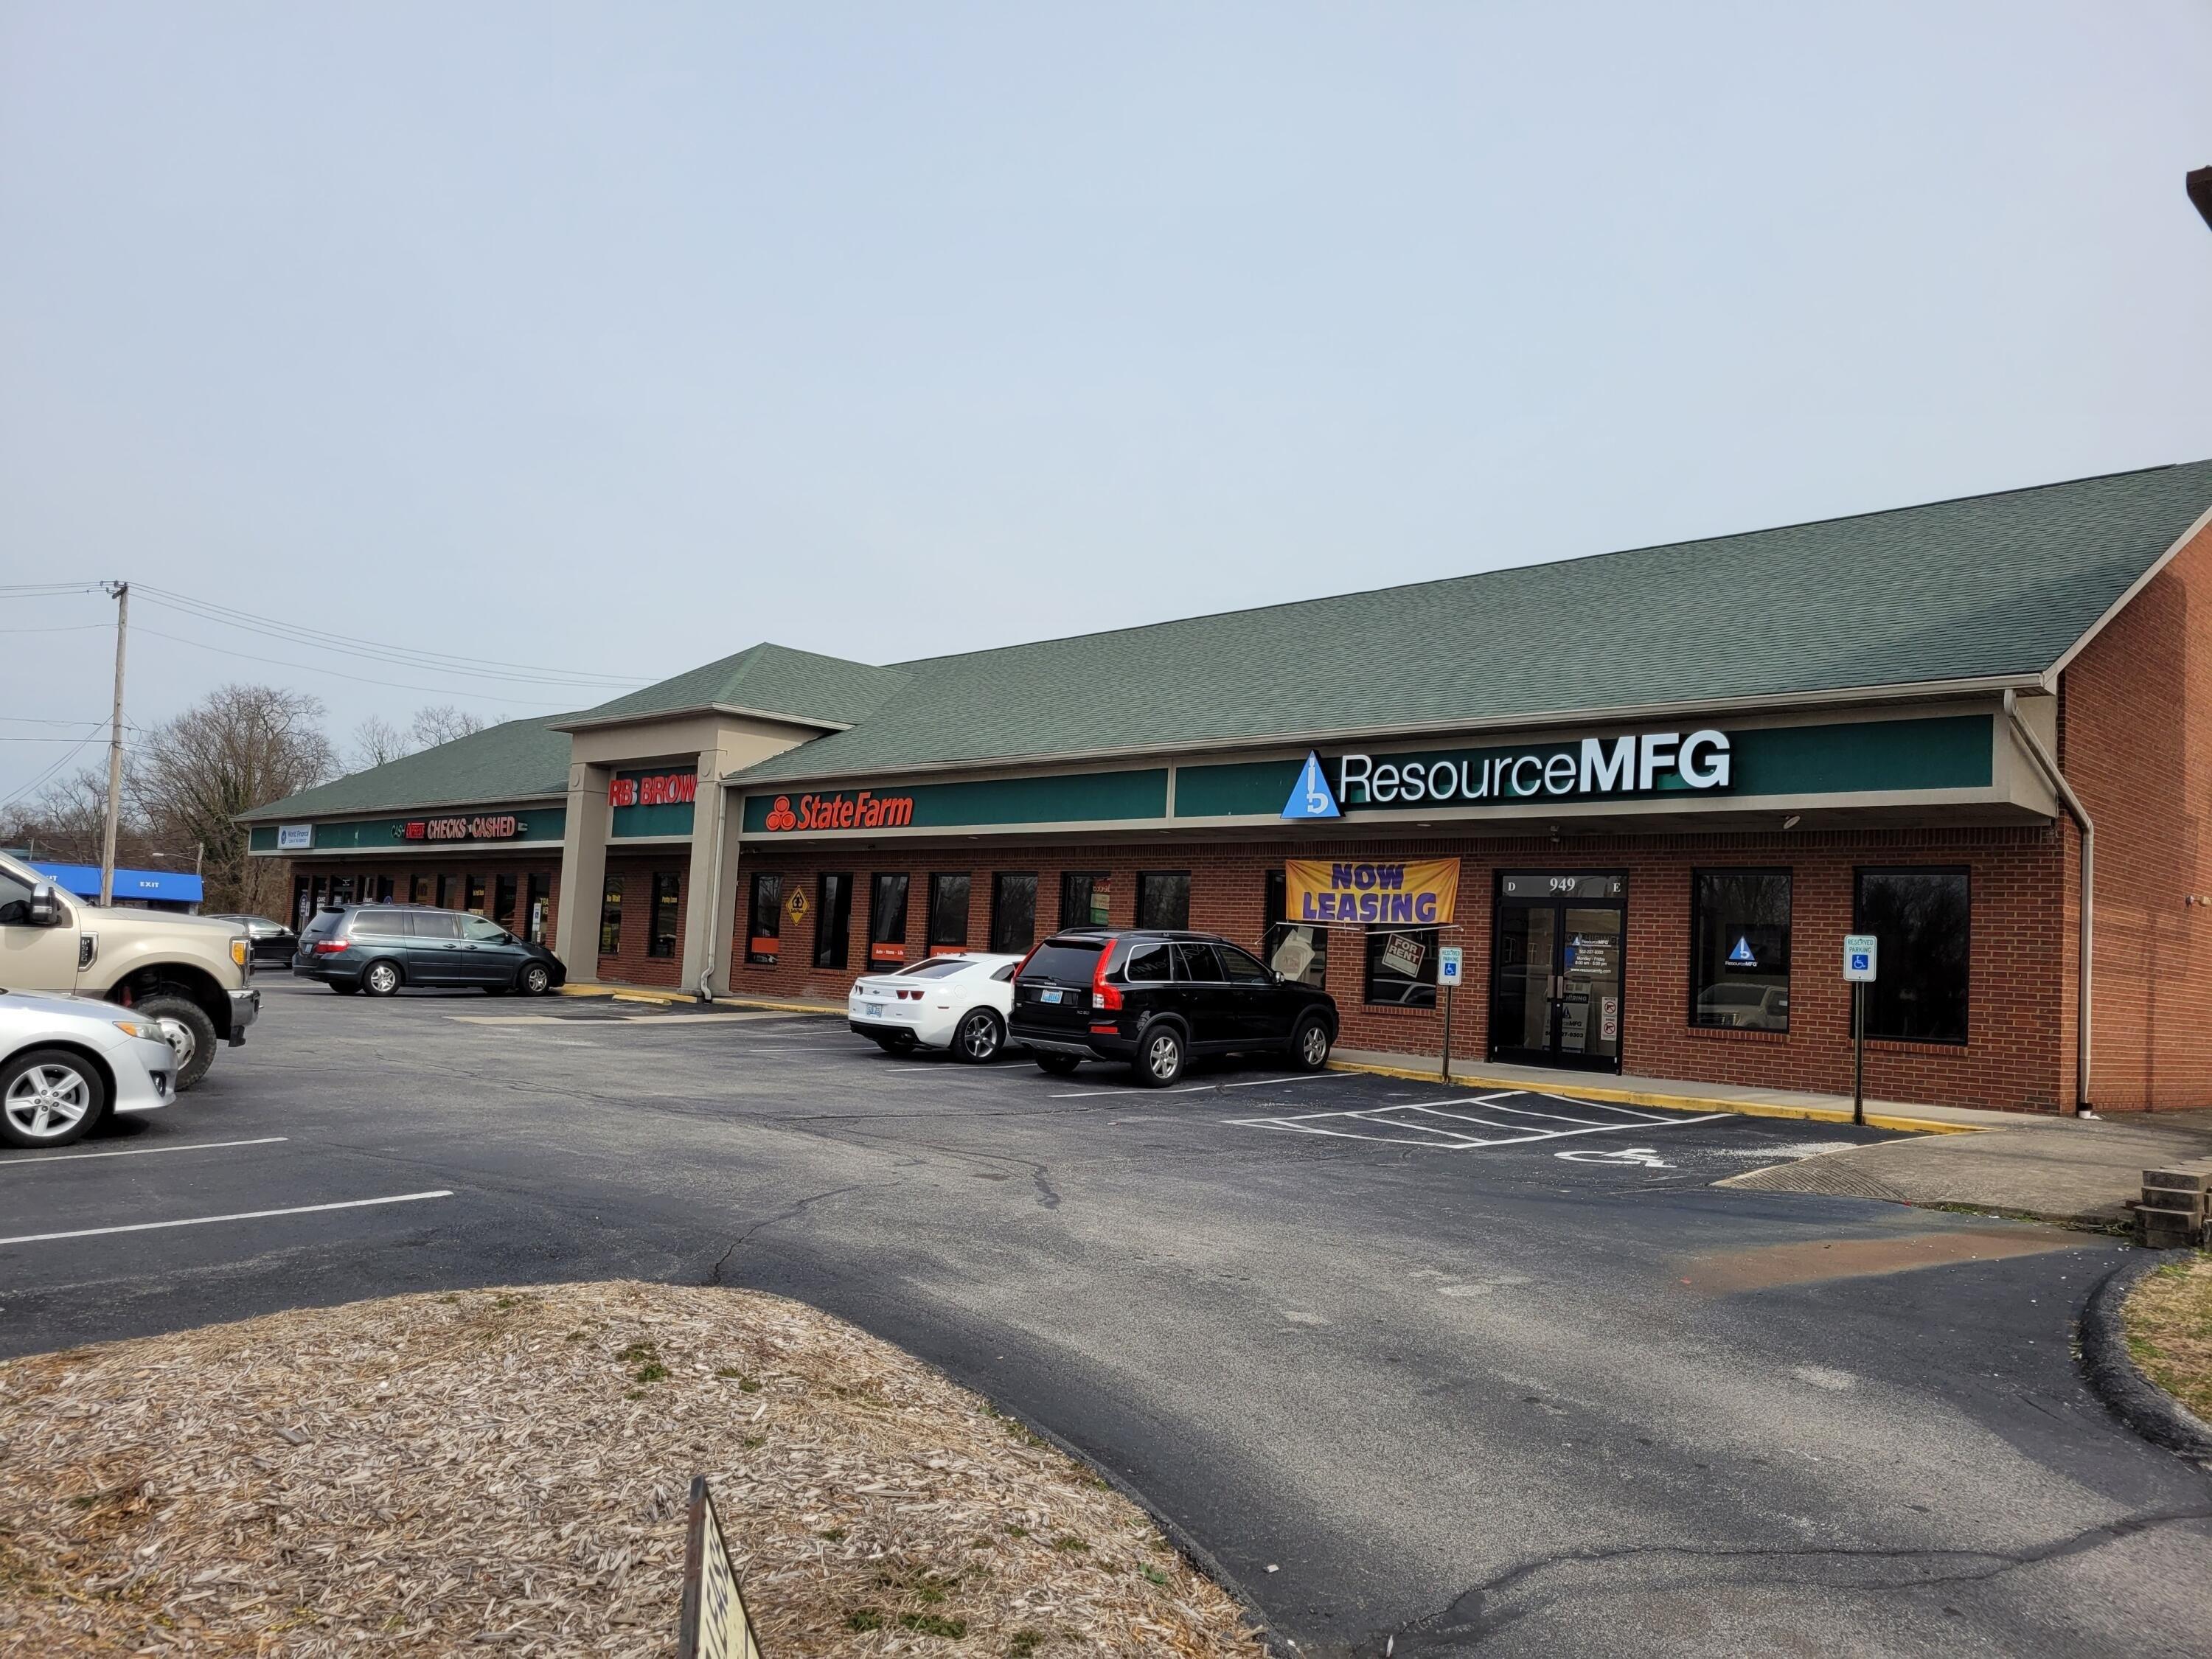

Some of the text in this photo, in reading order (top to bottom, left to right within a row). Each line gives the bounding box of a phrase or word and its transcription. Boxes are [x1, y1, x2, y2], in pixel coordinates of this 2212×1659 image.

[1340, 730, 1731, 803] ResourceMFG
[608, 779, 636, 807] RB
[391, 825, 406, 838] CASH
[427, 818, 467, 840] CHECKS
[472, 816, 515, 838] CASHED
[1332, 863, 1405, 890] NOW
[1508, 882, 1516, 891] D
[1550, 877, 1576, 891] 949
[1613, 883, 1621, 892] E
[1303, 891, 1436, 922] LEASING
[1388, 946, 1420, 964] RENT
[1394, 938, 1418, 953] FOR
